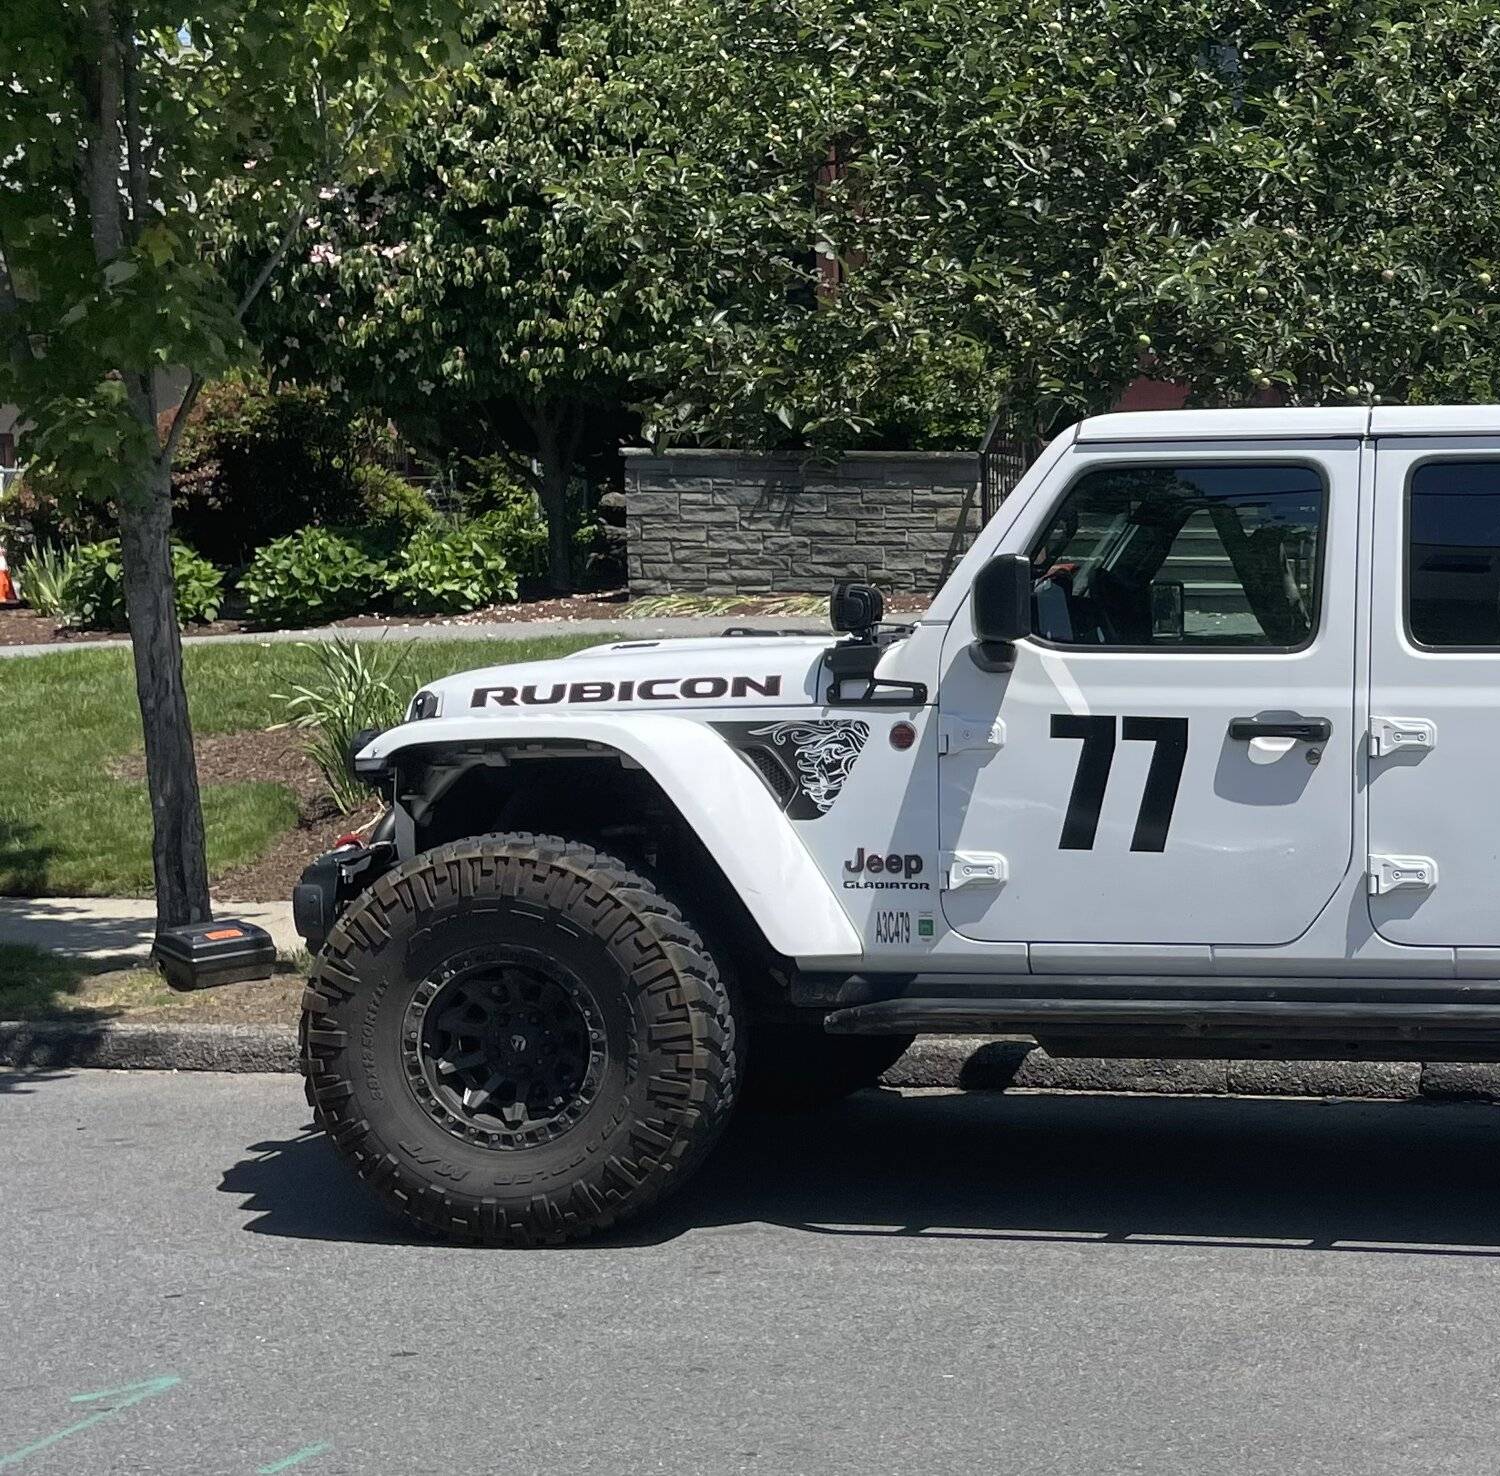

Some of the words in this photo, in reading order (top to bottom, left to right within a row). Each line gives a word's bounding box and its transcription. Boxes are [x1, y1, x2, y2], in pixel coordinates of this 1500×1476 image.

[470, 674, 782, 708] RUBICON
[1050, 714, 1189, 853] 77
[844, 847, 924, 880] Jeep
[843, 881, 931, 891] GLADIATOR
[876, 911, 911, 944] A3C479
